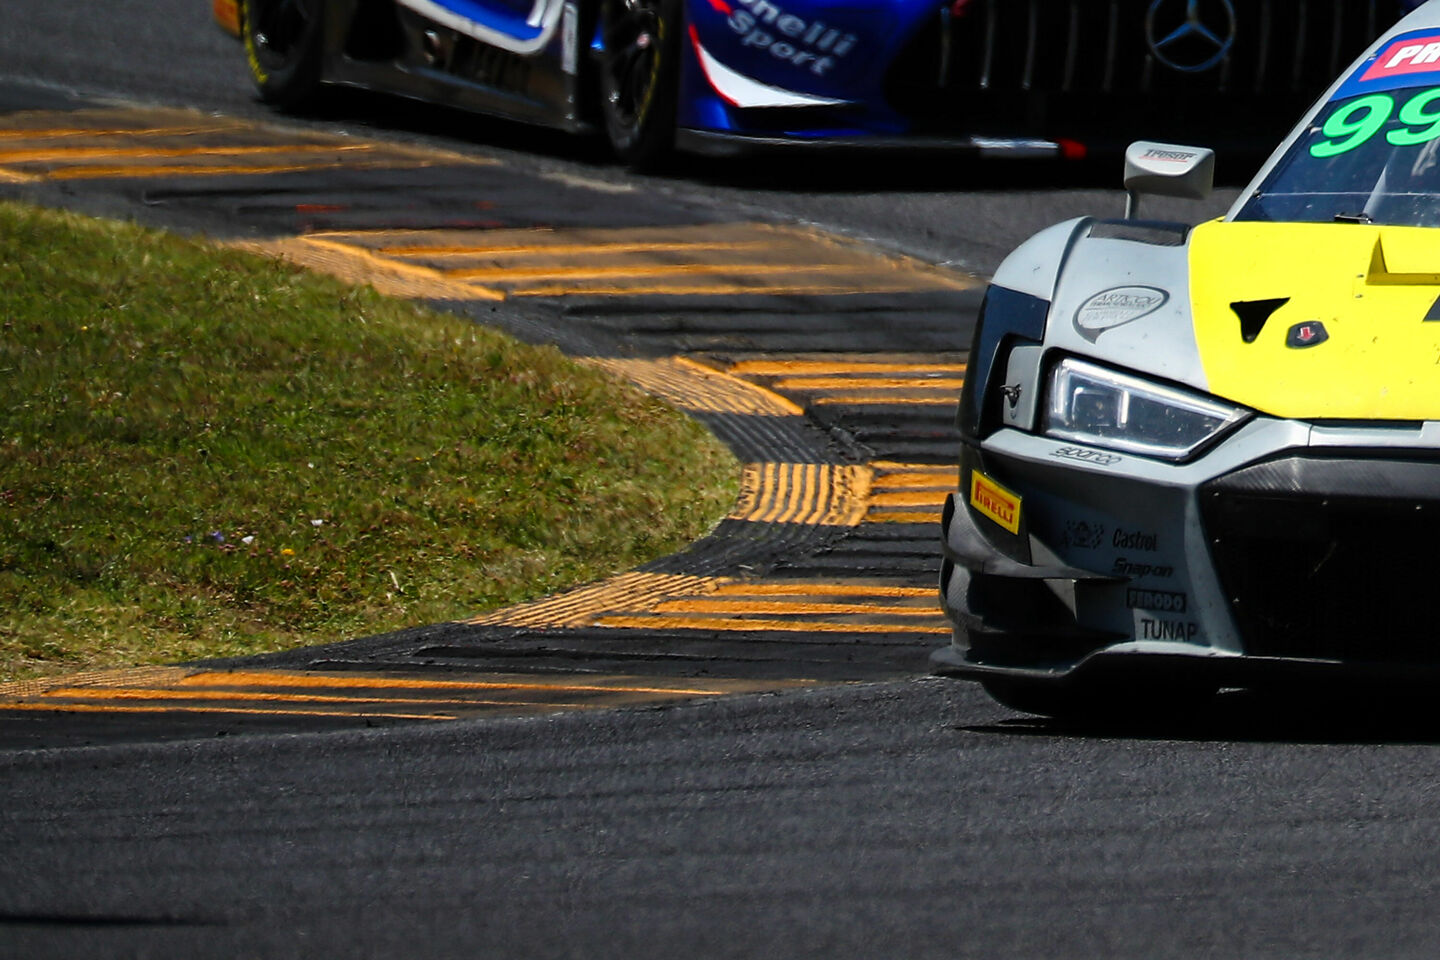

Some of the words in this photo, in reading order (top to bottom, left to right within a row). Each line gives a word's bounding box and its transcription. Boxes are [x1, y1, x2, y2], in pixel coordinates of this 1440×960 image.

[727, 8, 836, 76] Sport
[975, 479, 1015, 524] PIRELLI
[1112, 528, 1158, 553] Castrol
[1128, 590, 1185, 612] FERODO
[1141, 618, 1198, 642] TUNAP
